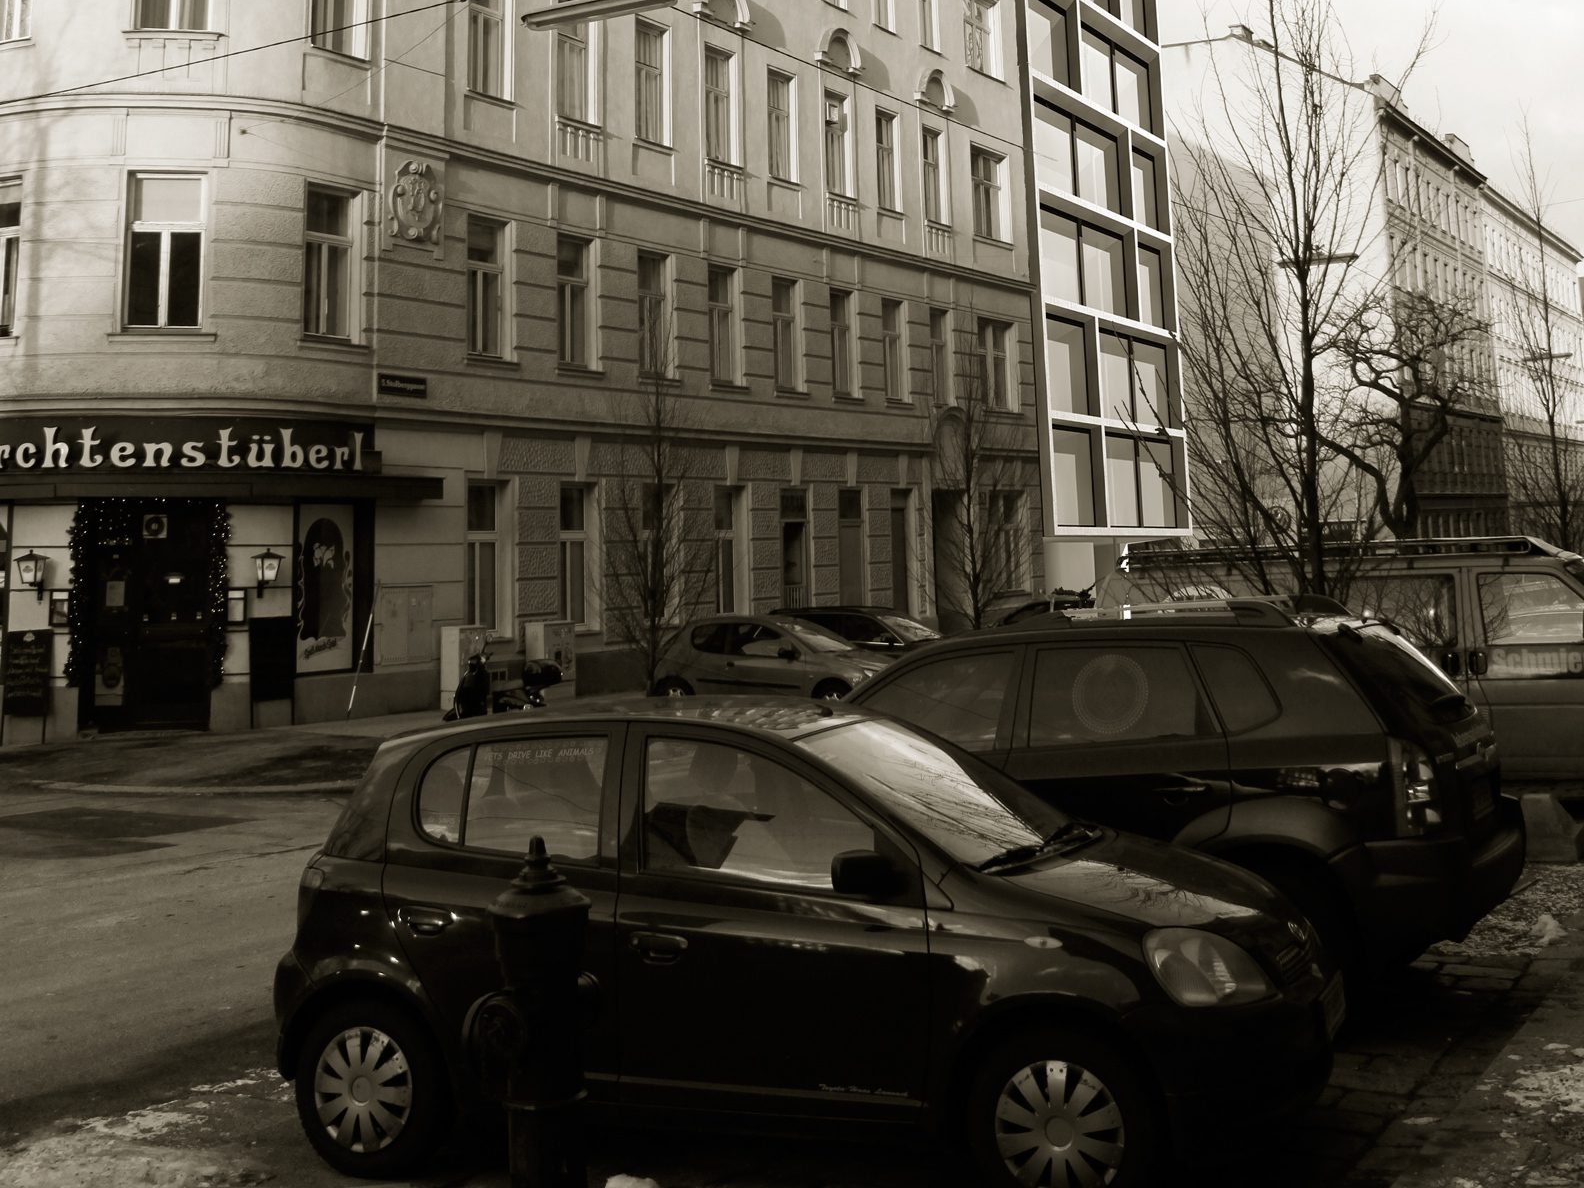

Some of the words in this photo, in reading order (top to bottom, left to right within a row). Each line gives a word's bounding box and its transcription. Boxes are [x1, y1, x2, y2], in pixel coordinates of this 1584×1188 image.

[1492, 648, 1584, 674] Schmie
[508, 749, 532, 760] DRIVE
[535, 748, 553, 758] LIKE
[558, 747, 595, 757] ANIMALS
